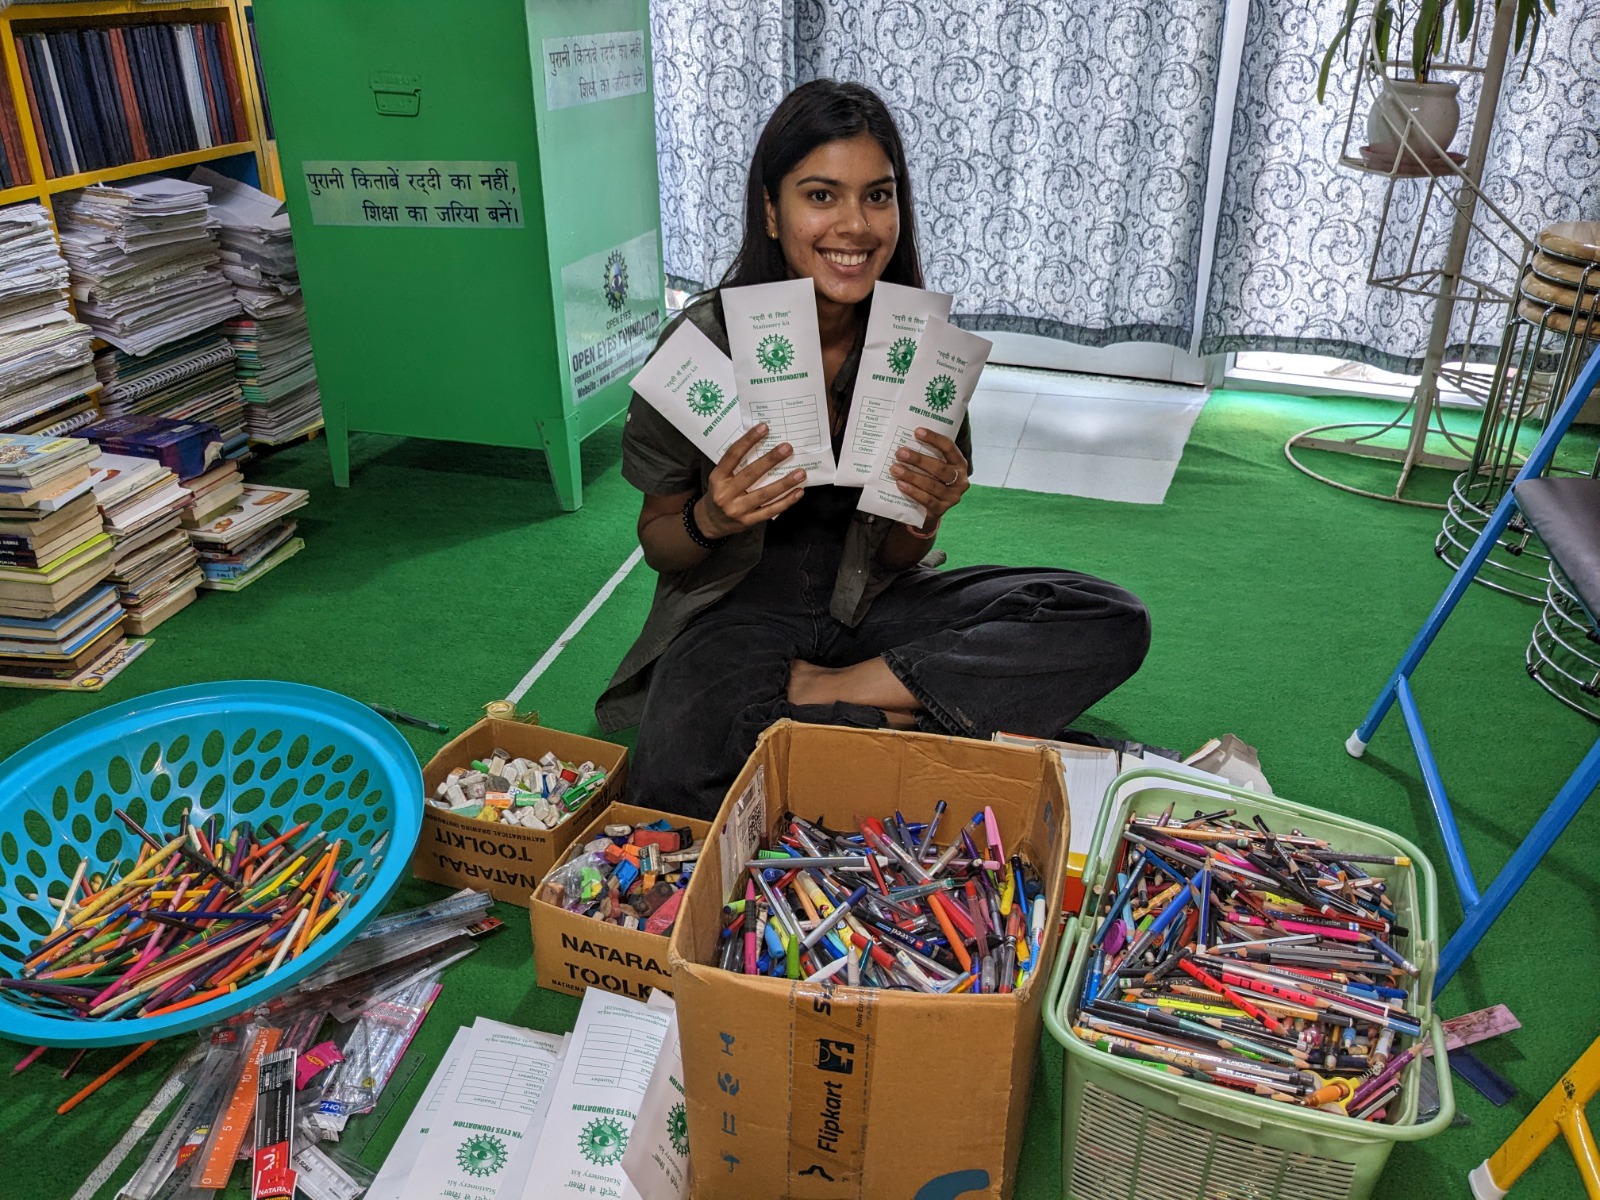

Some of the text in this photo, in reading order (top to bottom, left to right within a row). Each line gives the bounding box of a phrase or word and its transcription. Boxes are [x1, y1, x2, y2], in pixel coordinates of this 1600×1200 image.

[549, 44, 570, 77] पुरानी
[306, 167, 516, 195] पुरानी किताबें रद्दी का नहीं,
[362, 200, 518, 223] शिक्षा का जरिया बनें।
[606, 309, 631, 330] OPEN EYES
[892, 323, 917, 333] Stationery
[572, 346, 596, 372] OPEN
[597, 335, 617, 359] EYES
[936, 360, 957, 372] Stationery
[672, 373, 692, 394] Stationery
[763, 376, 776, 384] EYES
[776, 371, 809, 382] FOUNDATION
[885, 375, 897, 383] EYES
[909, 405, 954, 426] OPEN EYES FOUNDATION
[703, 425, 713, 437] OPEN
[711, 416, 721, 427] EYES
[461, 824, 491, 835] DRAWING
[493, 830, 546, 843] MATHEMATICAL
[435, 827, 533, 862] TOOLKIT
[241, 1075, 252, 1083] 10
[260, 1029, 270, 1038] 15
[473, 1097, 497, 1105] Number
[572, 1104, 615, 1115] FOUNDATION
[615, 1108, 632, 1119] EYES
[817, 1080, 845, 1153] Flipkart
[452, 1121, 495, 1133] FOUNDATION
[495, 1127, 512, 1136] EYES
[299, 1161, 312, 1173] SCALE
[583, 1170, 622, 1186] Stationery
[258, 1186, 292, 1195] NATARAJ
[447, 1179, 497, 1195] Stationery kit
